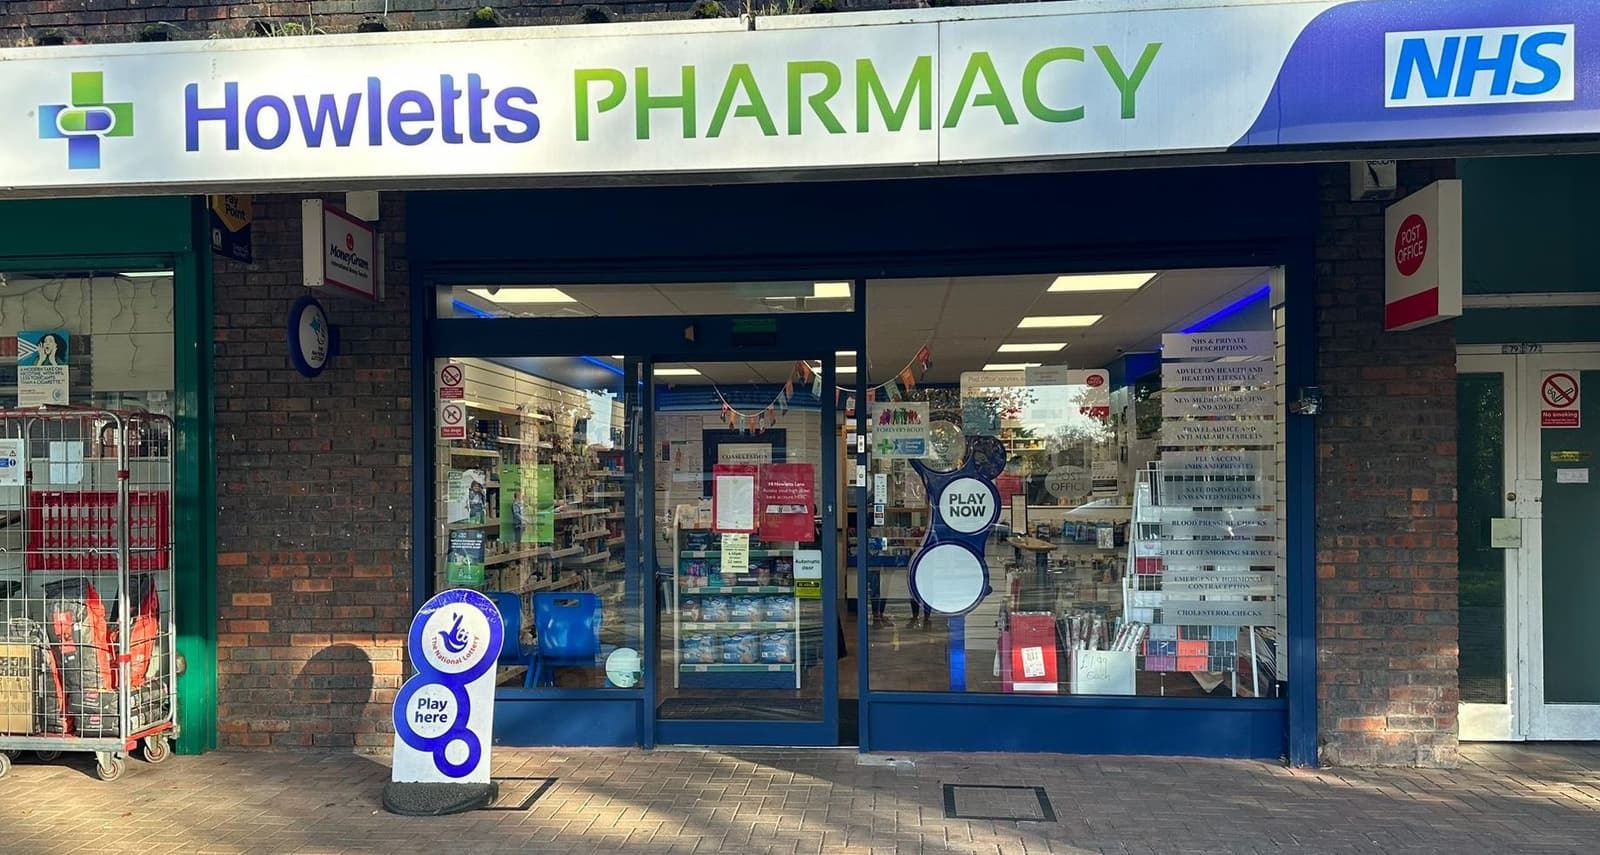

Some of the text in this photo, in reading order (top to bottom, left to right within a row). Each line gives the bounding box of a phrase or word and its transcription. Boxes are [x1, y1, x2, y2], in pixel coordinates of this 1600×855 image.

[1390, 32, 1566, 100] NHS
[184, 42, 1162, 152] Howletts PHARMACY
[1401, 224, 1421, 246] POST
[330, 243, 369, 271] MoneyGram
[1397, 239, 1424, 264] OFFICE
[1056, 472, 1081, 481] POST
[1051, 482, 1087, 492] OFFICE
[949, 493, 986, 505] PLAY
[949, 506, 986, 517] NOW
[434, 649, 463, 665] National
[462, 635, 480, 661] Lottery
[417, 698, 448, 713] Play
[414, 711, 449, 724] here
